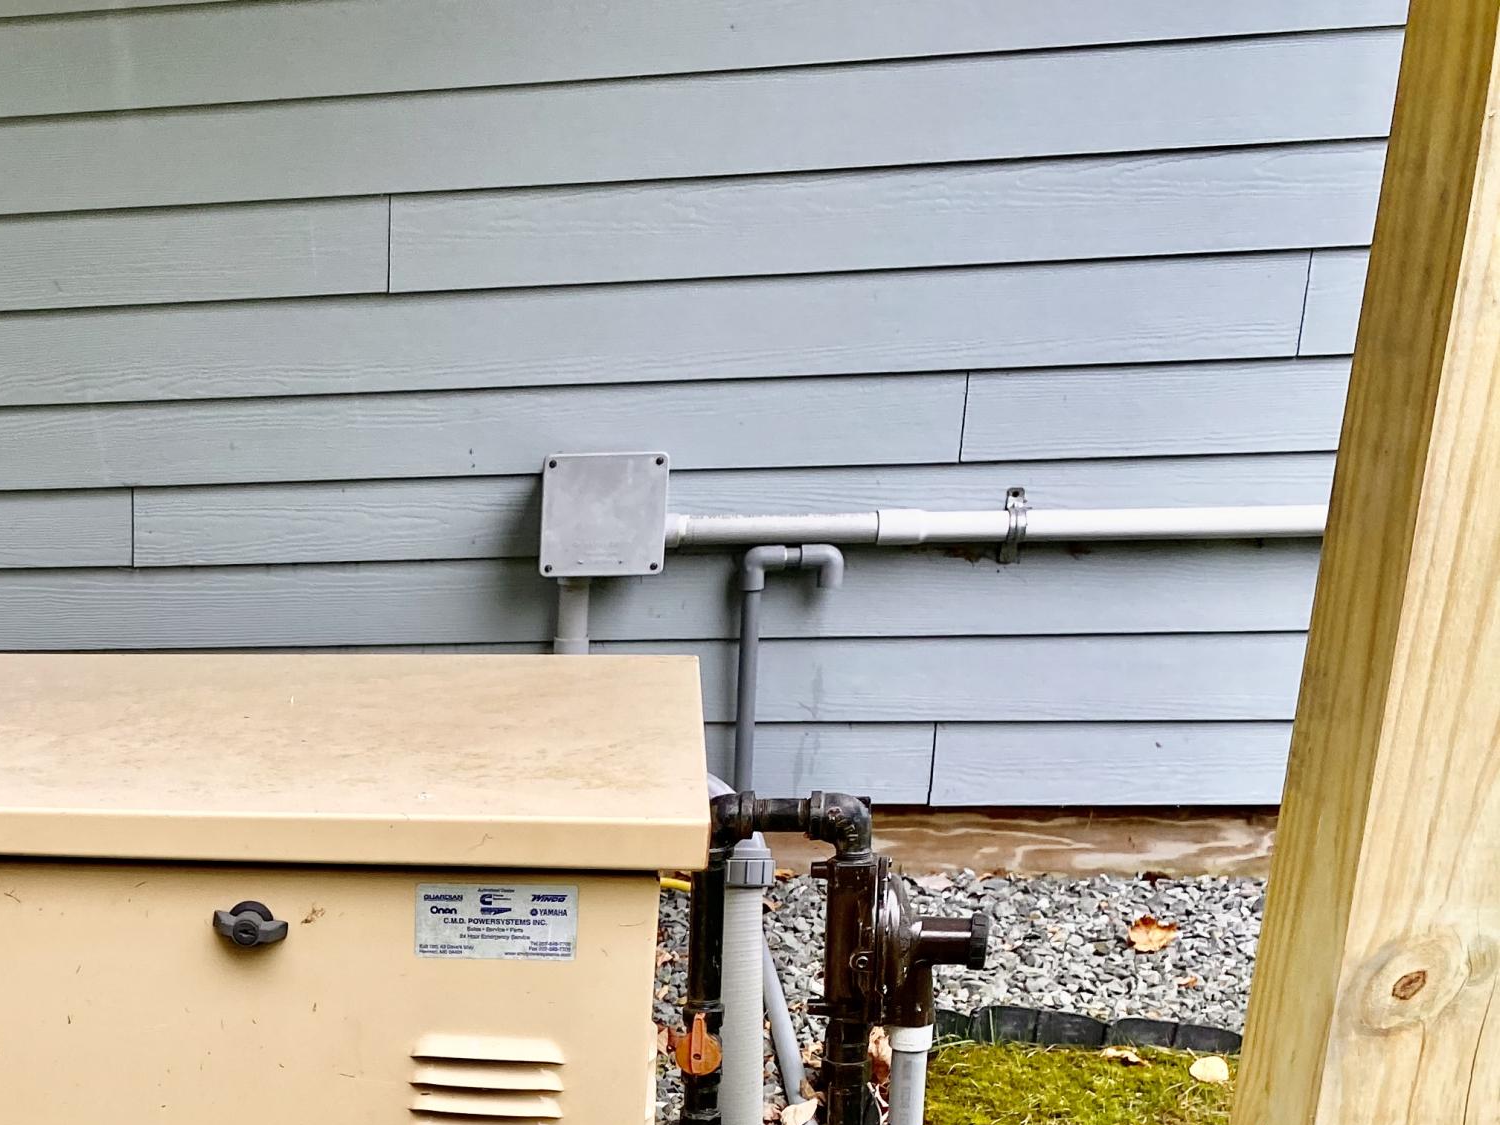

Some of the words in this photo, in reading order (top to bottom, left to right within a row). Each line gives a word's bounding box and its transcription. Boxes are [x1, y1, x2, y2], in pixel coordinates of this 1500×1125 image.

[531, 894, 568, 903] WINCO
[539, 908, 568, 917] YAMAHA
[467, 918, 531, 926] POWERSYSTEMS
